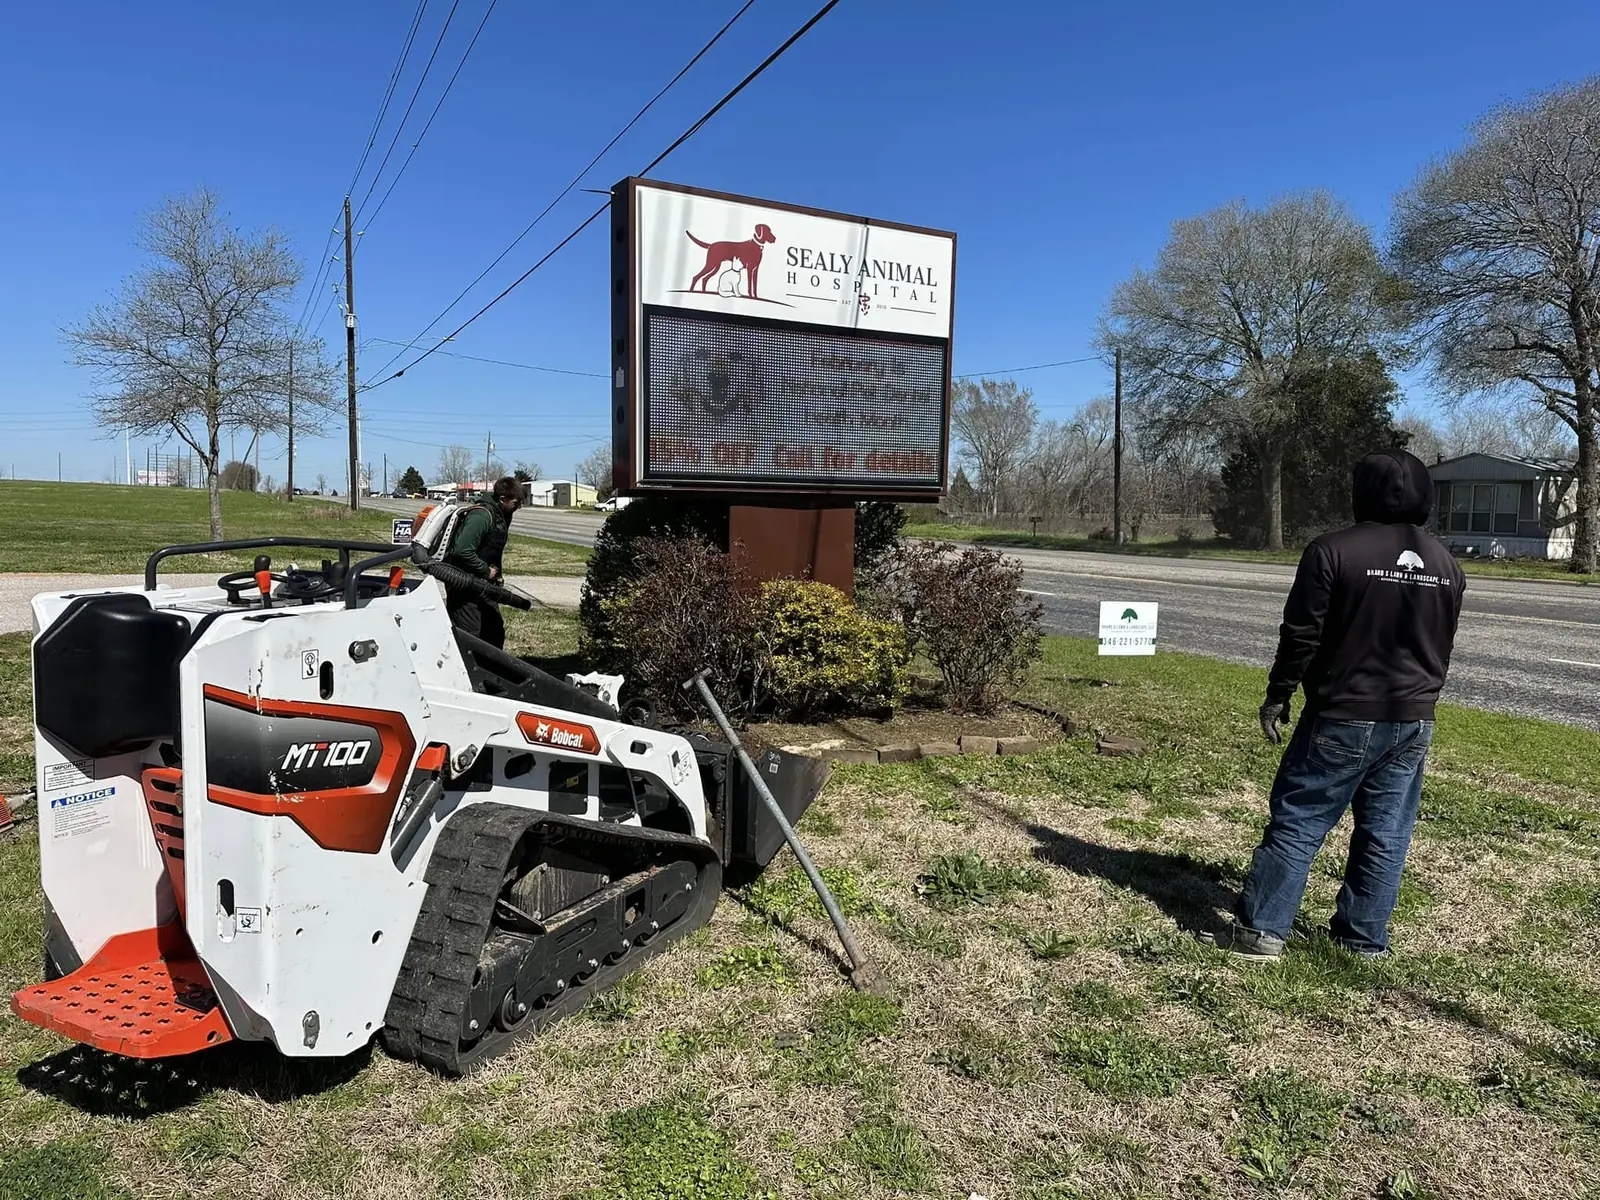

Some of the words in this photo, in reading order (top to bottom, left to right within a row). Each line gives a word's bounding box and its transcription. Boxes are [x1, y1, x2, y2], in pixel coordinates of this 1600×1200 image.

[786, 246, 853, 275] SEALY
[858, 258, 938, 287] ANIMAL
[786, 271, 938, 304] HOSPITAL
[712, 442, 757, 467] OFF
[773, 445, 814, 469] Call
[823, 447, 857, 469] for
[551, 728, 583, 747] Bobcat
[281, 740, 372, 770] MT100
[66, 788, 113, 805] NOTICE
